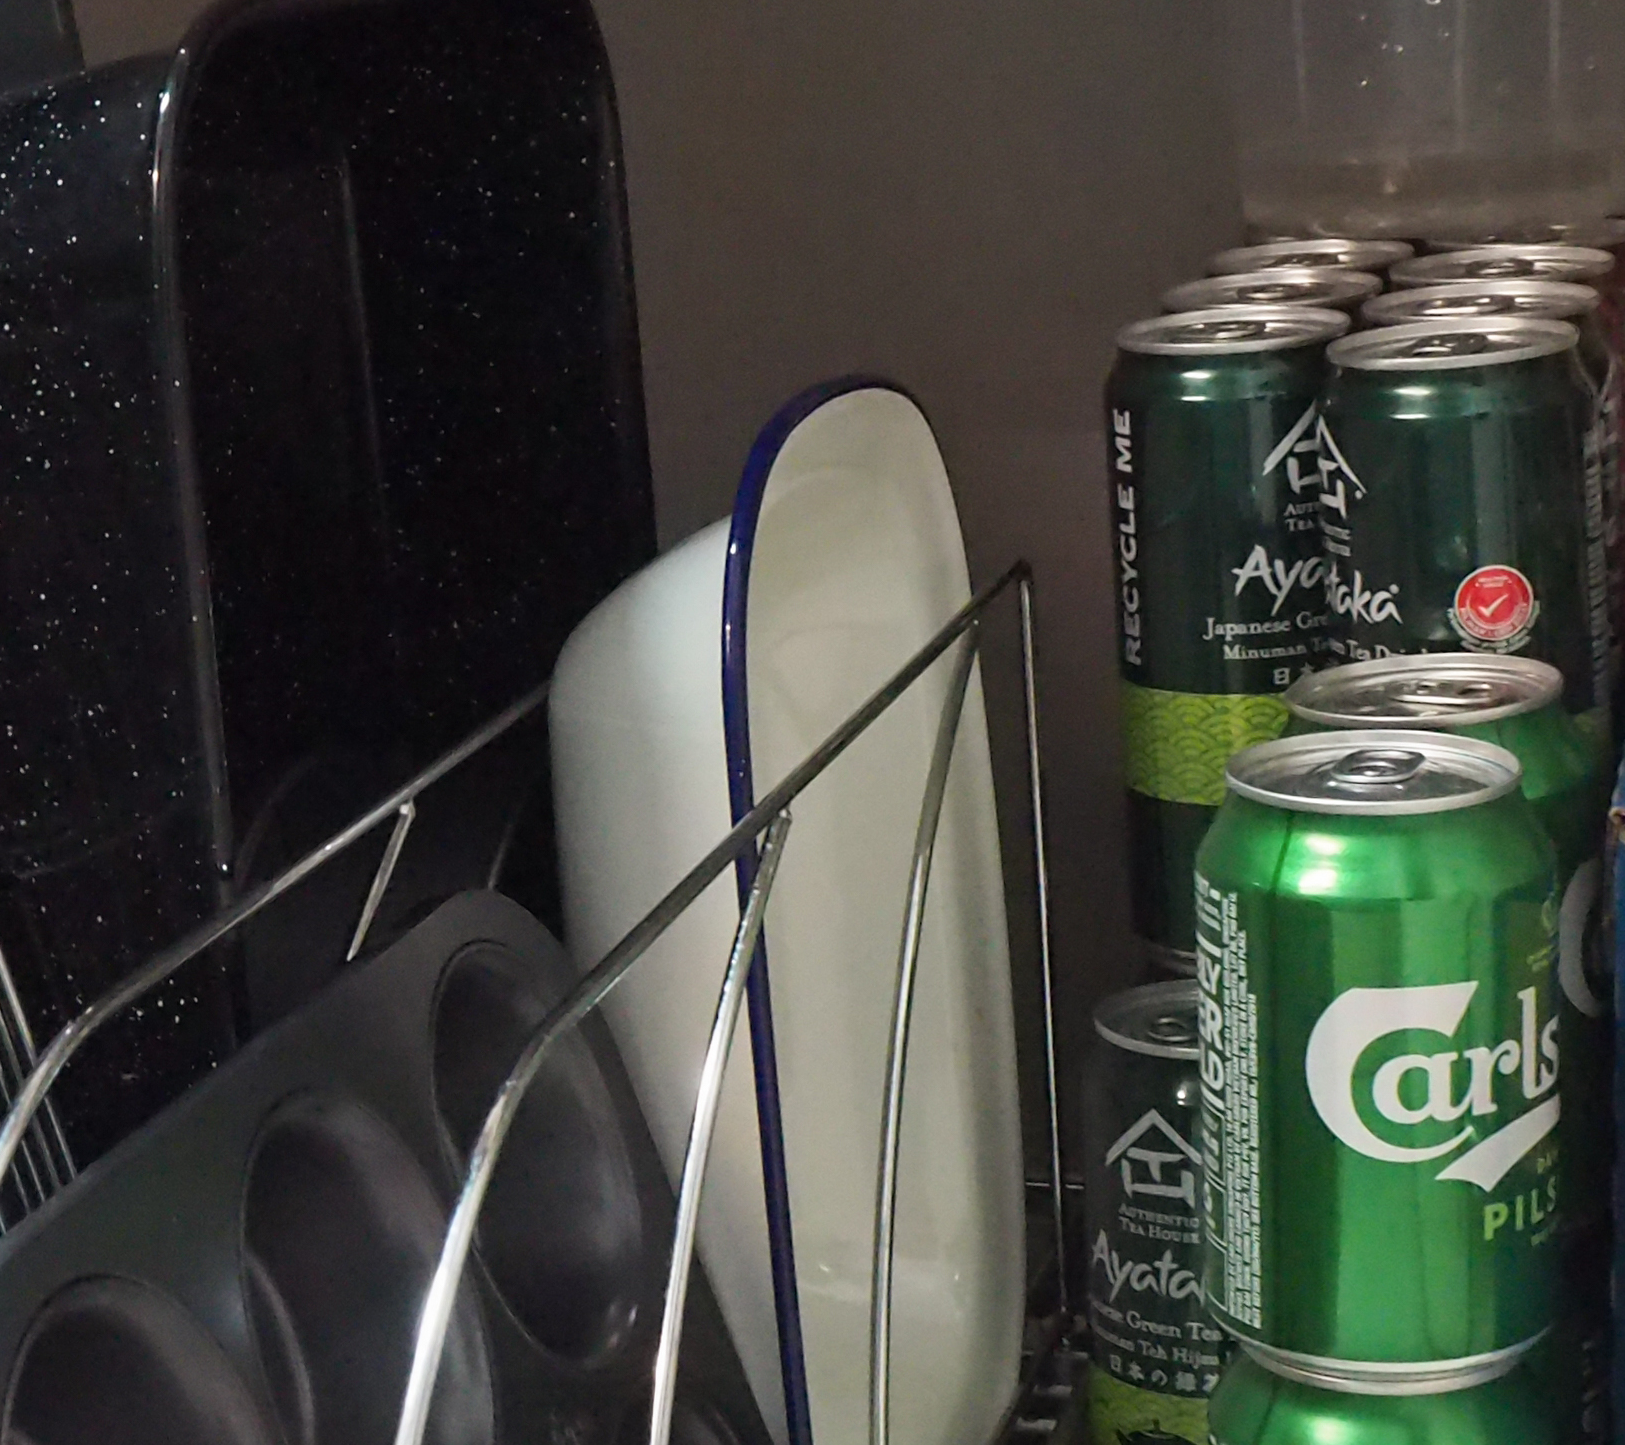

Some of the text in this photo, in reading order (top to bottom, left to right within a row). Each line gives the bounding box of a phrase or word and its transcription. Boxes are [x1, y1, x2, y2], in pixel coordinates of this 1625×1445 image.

[1112, 407, 1142, 666] RECYCLE ME
[1202, 615, 1291, 641] Japanese
[1222, 638, 1307, 660] Minuman
[1306, 980, 1560, 1163] Carls
[1484, 1177, 1559, 1241] PILS
[1091, 1228, 1207, 1306] Ayata
